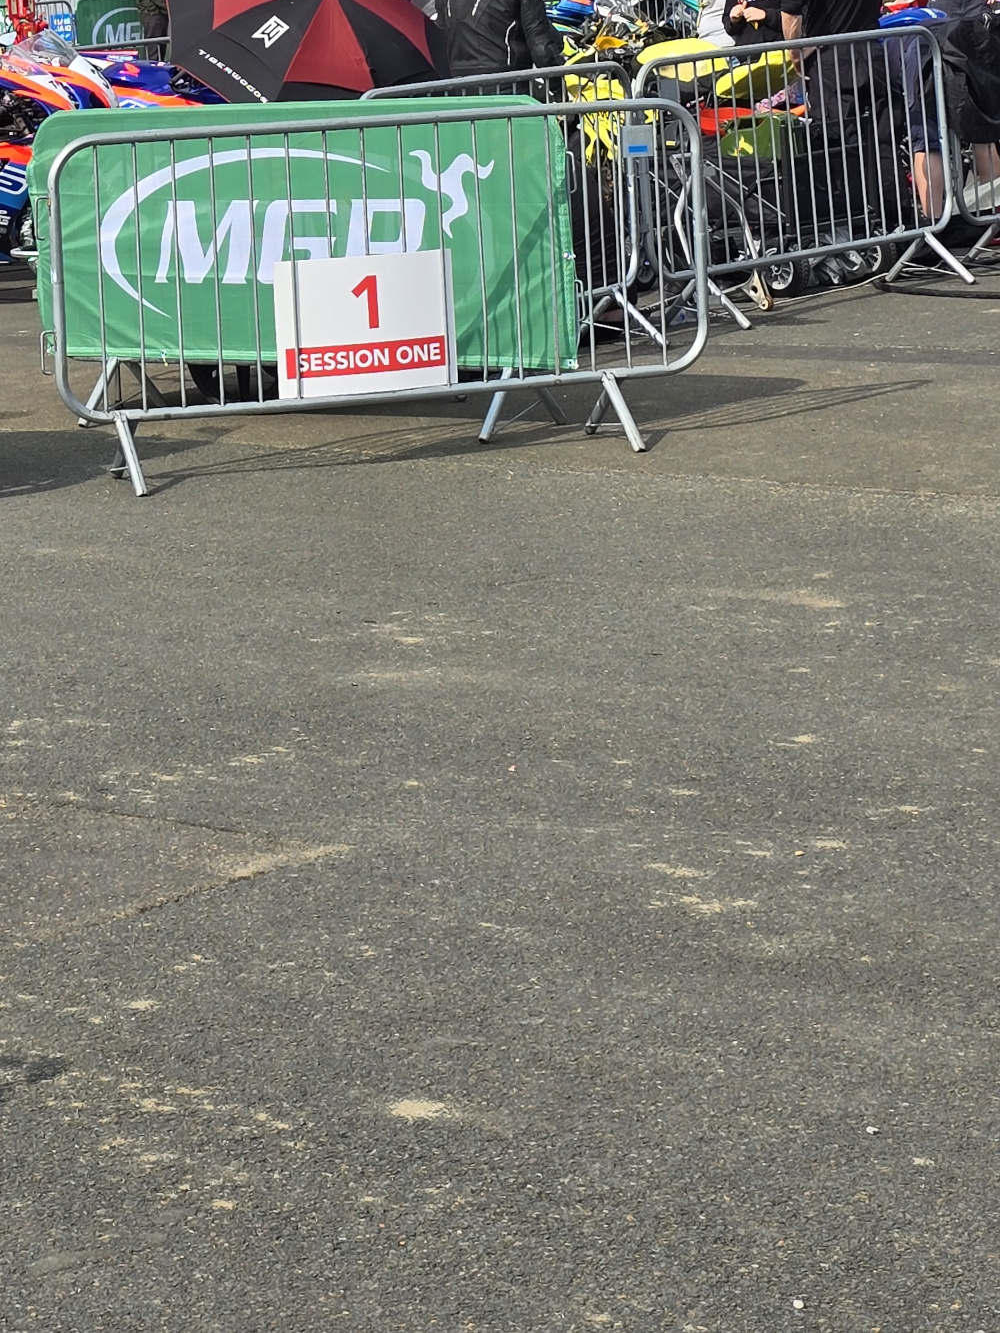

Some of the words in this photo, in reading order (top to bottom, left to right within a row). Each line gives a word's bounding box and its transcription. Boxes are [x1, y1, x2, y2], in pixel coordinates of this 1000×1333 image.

[154, 199, 426, 285] MGP
[351, 274, 380, 329] 1
[299, 348, 391, 372] SESSION
[396, 342, 442, 364] ONE
